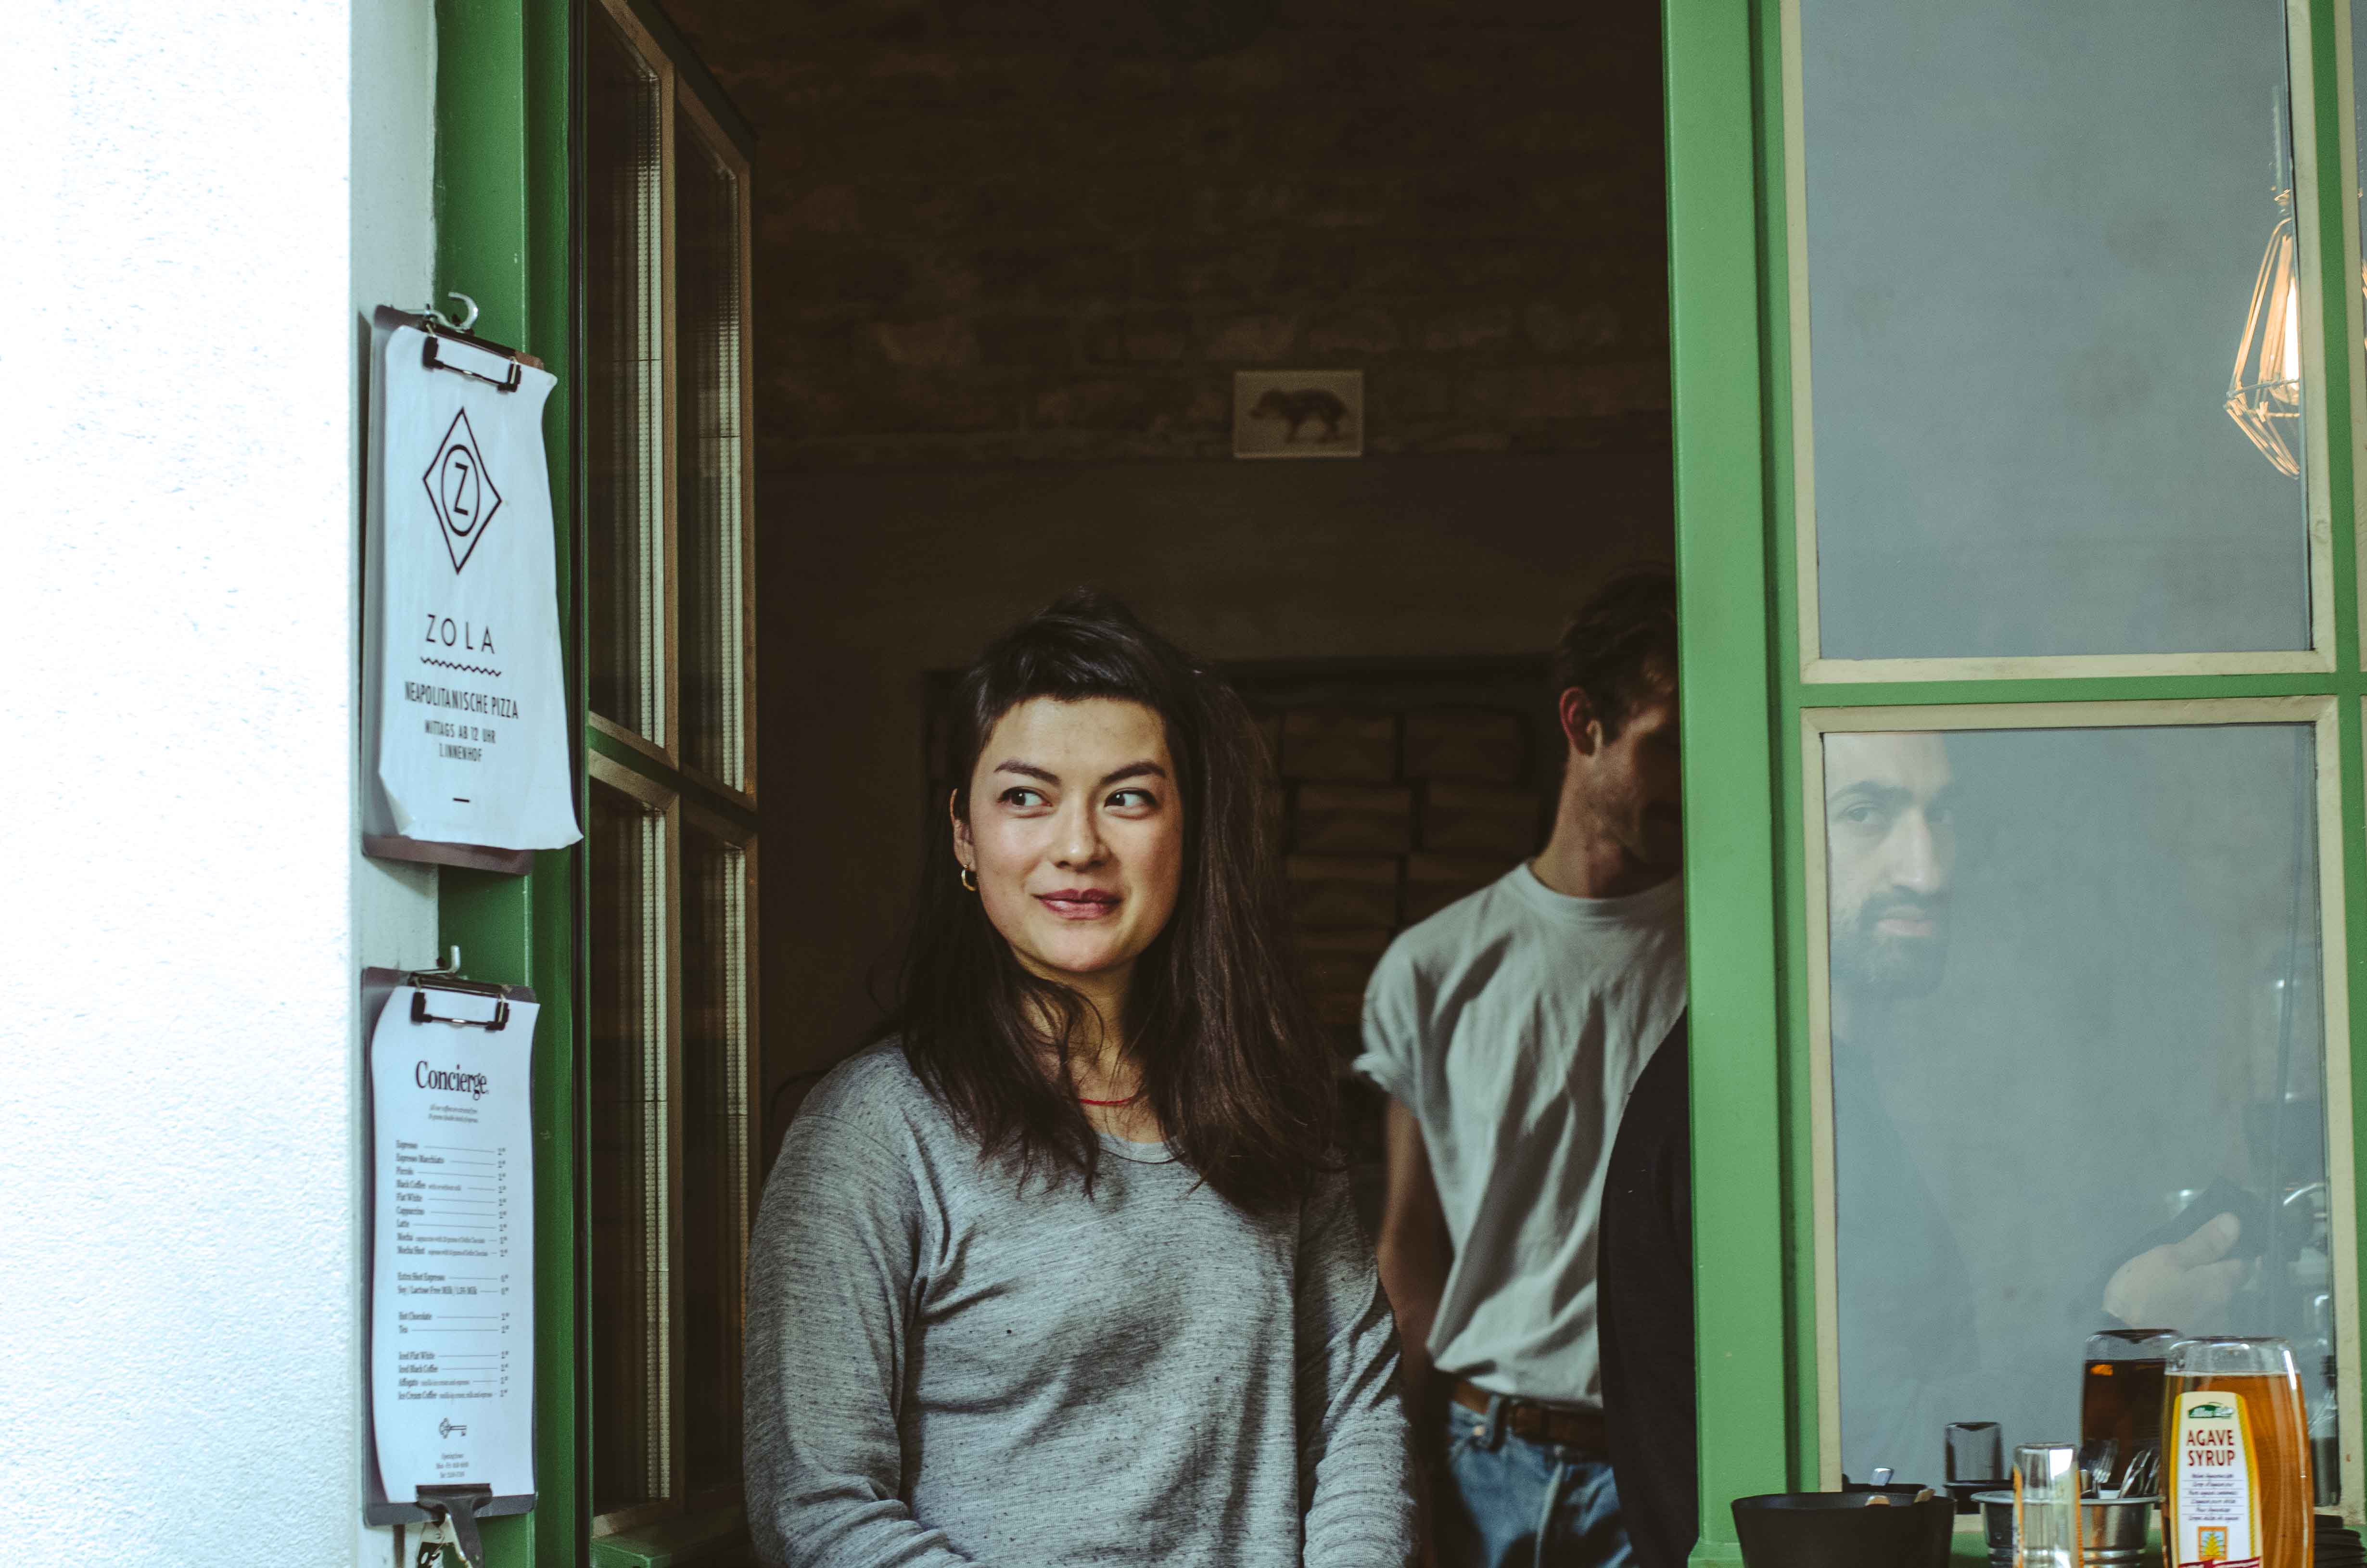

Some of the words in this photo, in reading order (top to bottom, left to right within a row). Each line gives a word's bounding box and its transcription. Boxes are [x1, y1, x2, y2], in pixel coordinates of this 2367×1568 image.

[454, 462, 469, 515] Z
[426, 614, 495, 654] ZOLA
[405, 681, 488, 714] NEAPOLITANISCHE
[491, 697, 519, 719] PIZZA
[458, 725, 468, 739] AB
[471, 727, 479, 741] 12
[483, 728, 496, 743] UHR
[2187, 1429, 2234, 1446] AGAVE
[2188, 1450, 2235, 1466] SYRUP
